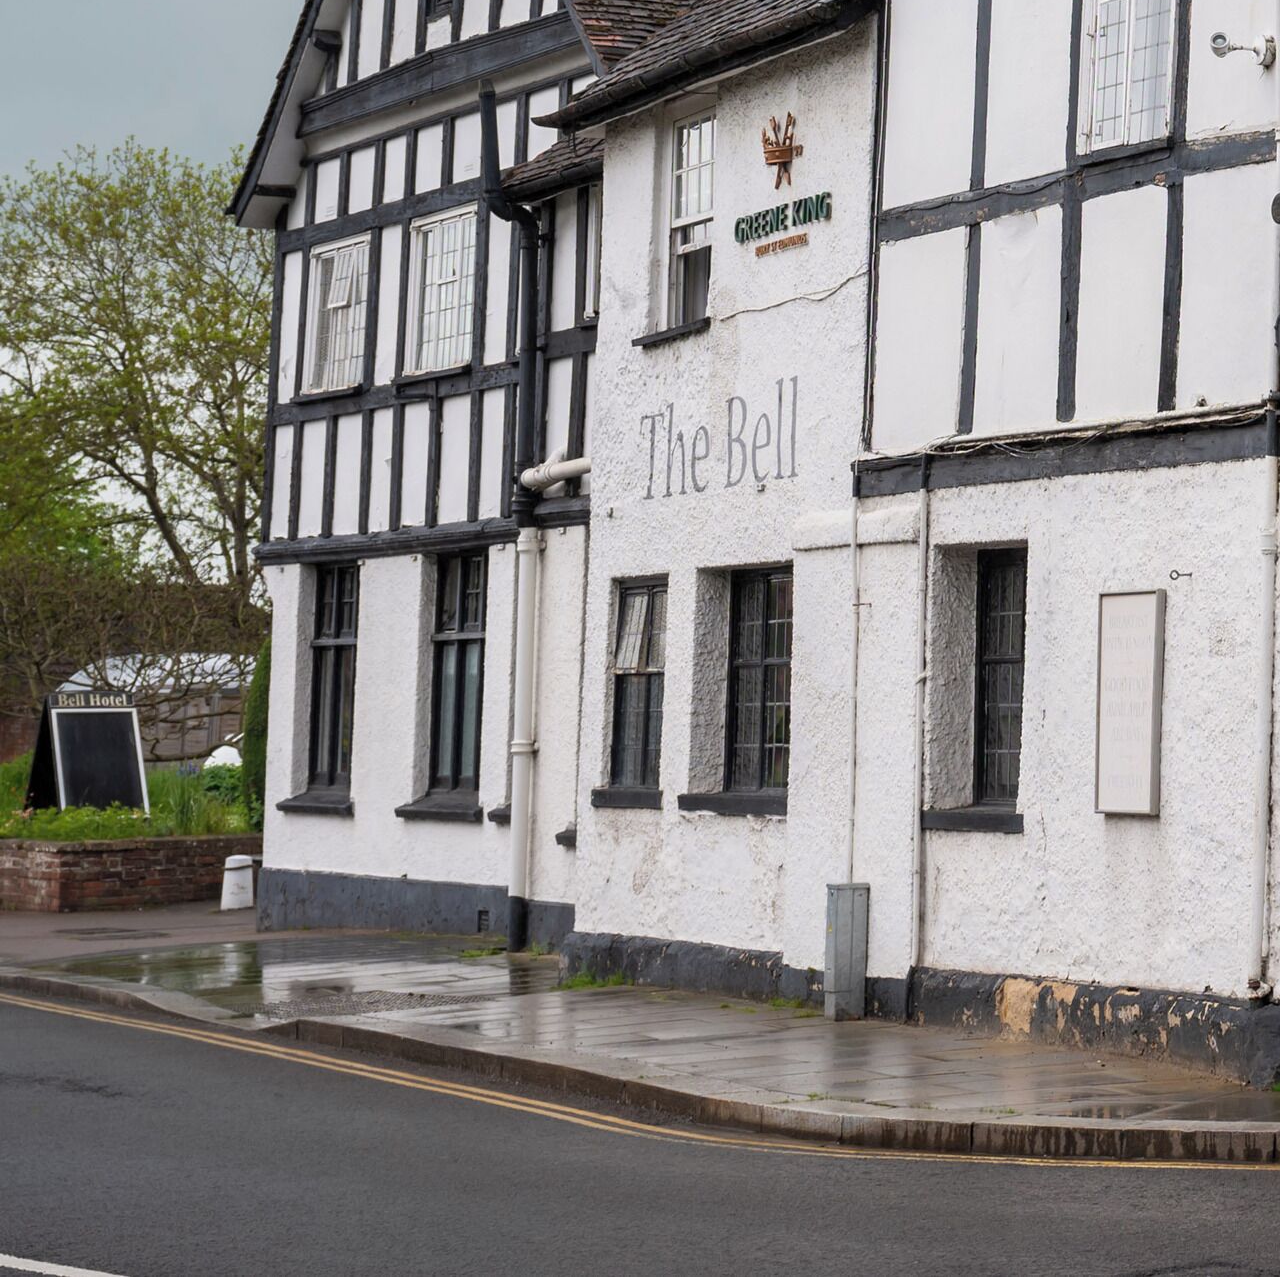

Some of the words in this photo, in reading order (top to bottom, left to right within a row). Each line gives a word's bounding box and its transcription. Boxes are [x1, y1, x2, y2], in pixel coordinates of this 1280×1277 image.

[734, 203, 789, 243] GREENE
[792, 191, 832, 227] KING
[640, 402, 710, 500] The
[724, 375, 798, 489] Bell
[58, 694, 85, 707] Bell
[89, 693, 128, 706] Hotel
